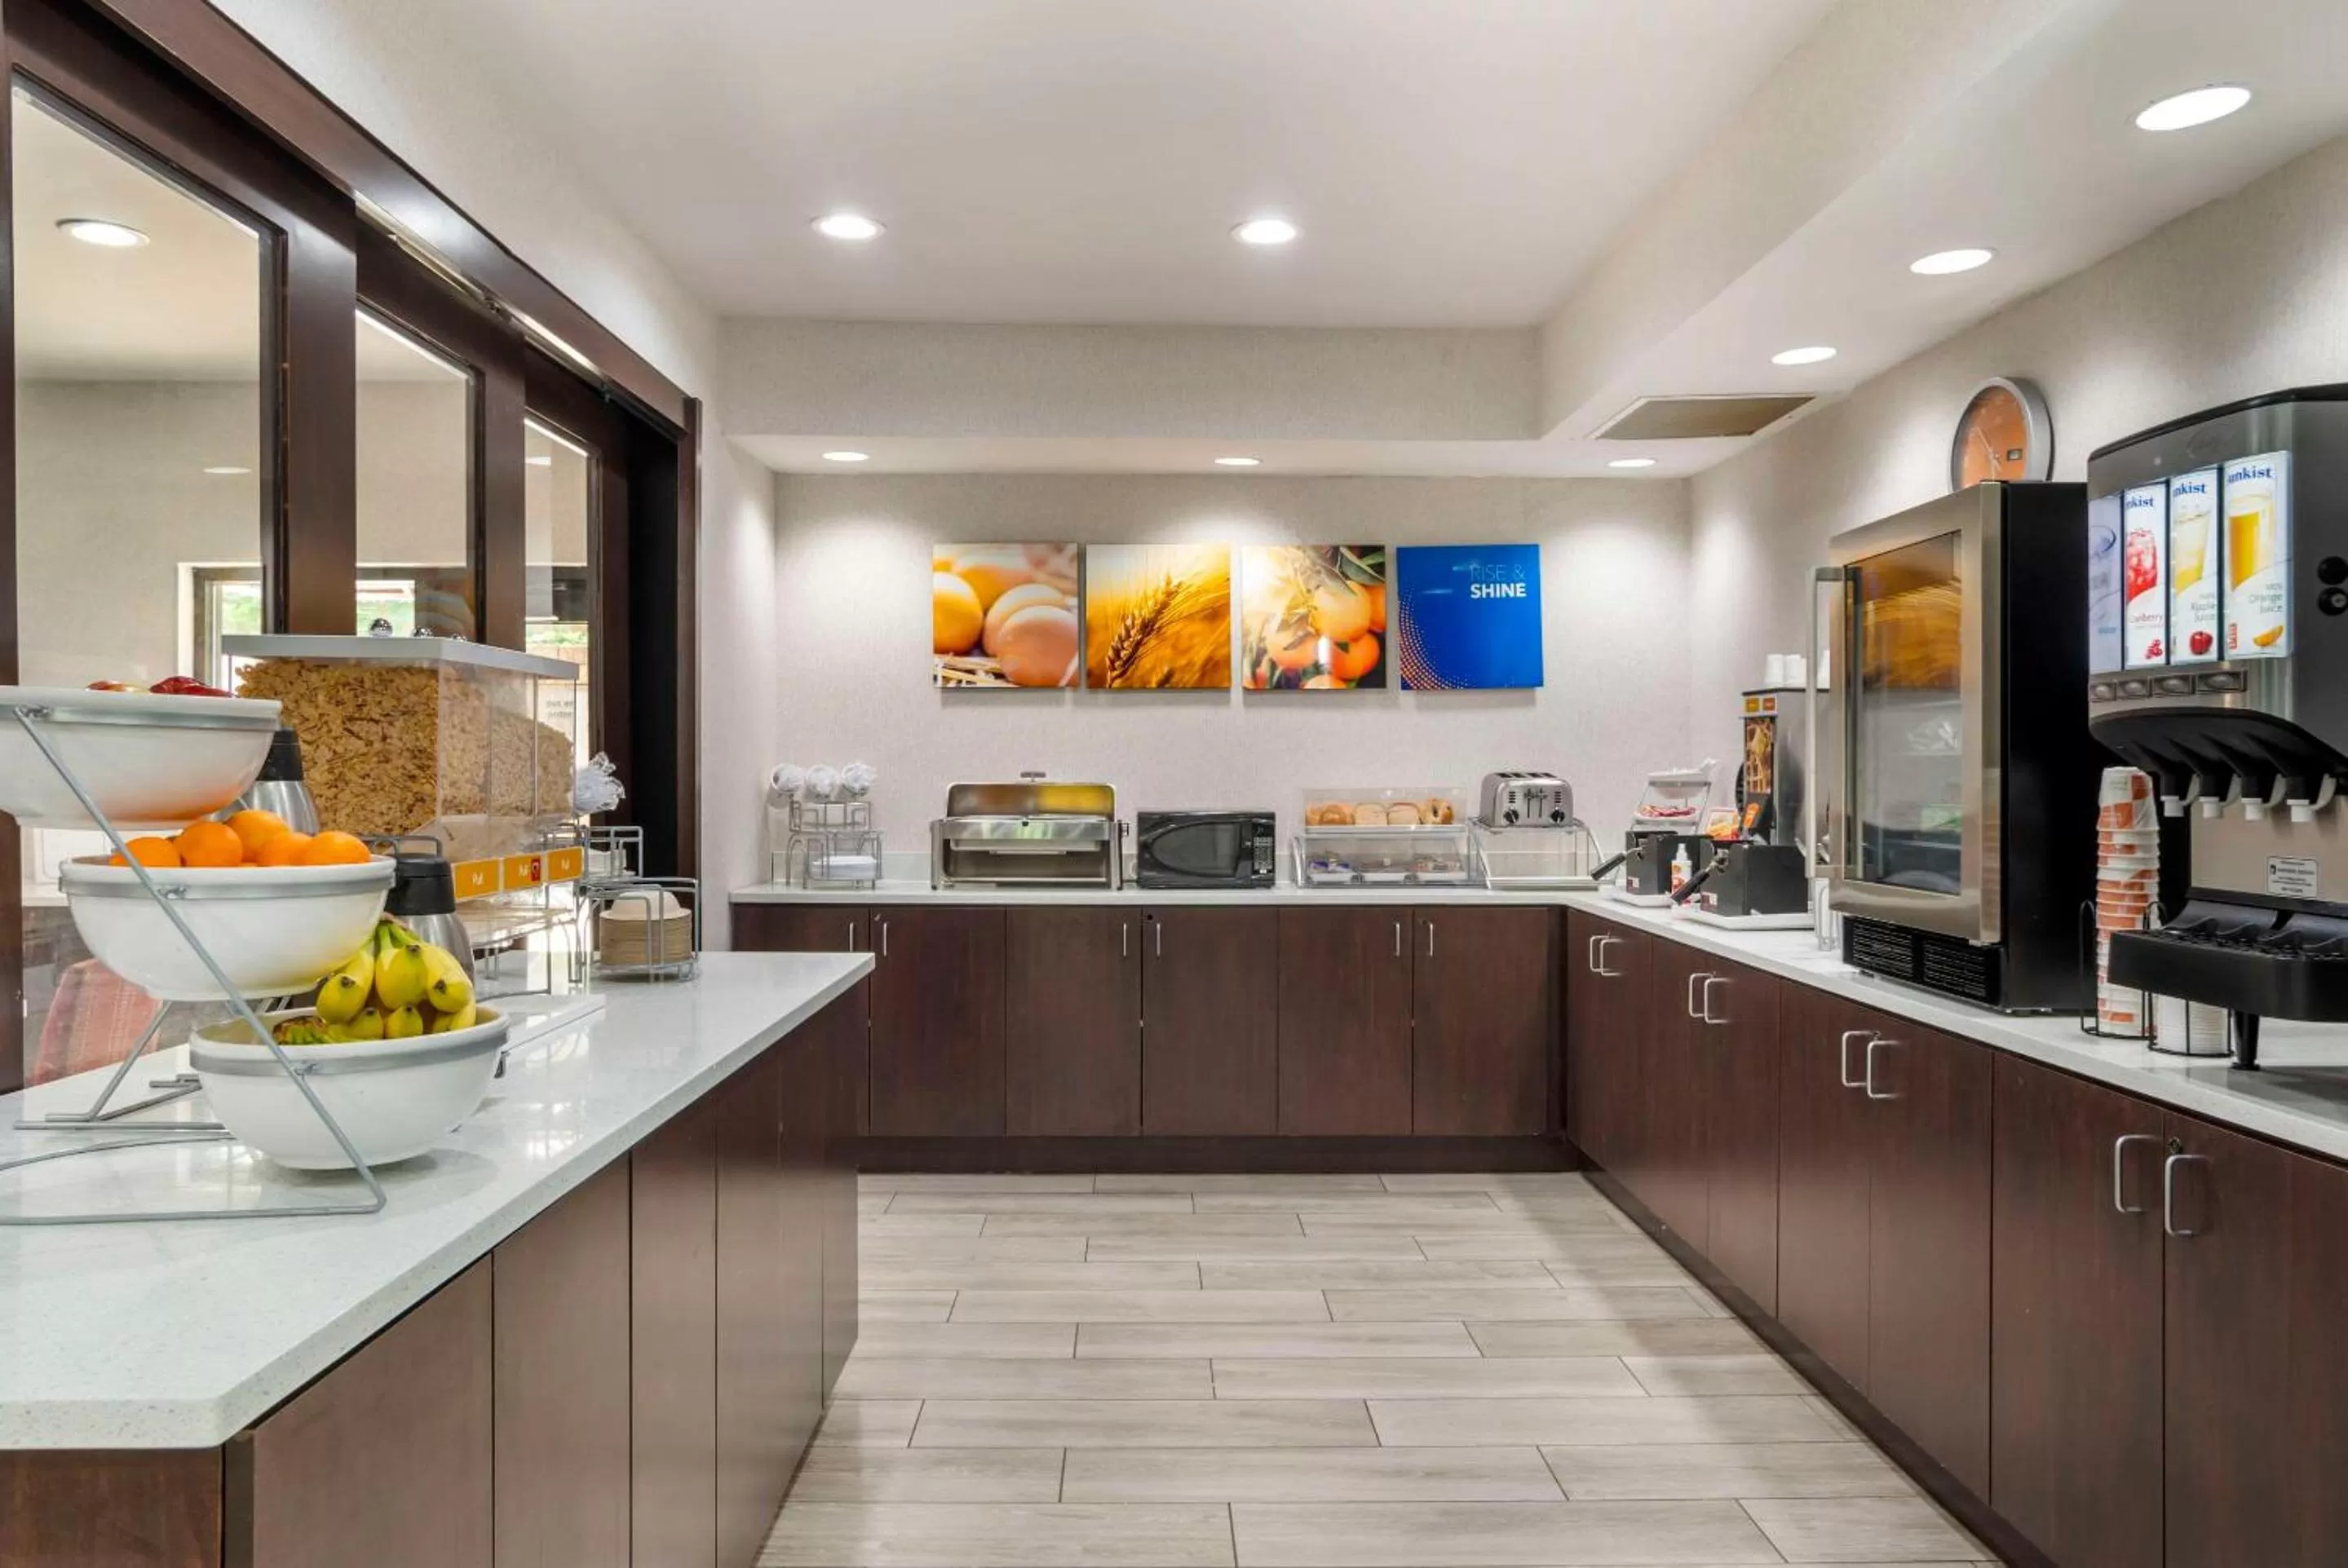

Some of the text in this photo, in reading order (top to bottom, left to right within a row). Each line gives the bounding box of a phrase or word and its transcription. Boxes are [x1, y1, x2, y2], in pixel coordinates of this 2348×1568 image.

[1470, 563, 1526, 581] RISE &
[1470, 582, 1528, 598] SHINE
